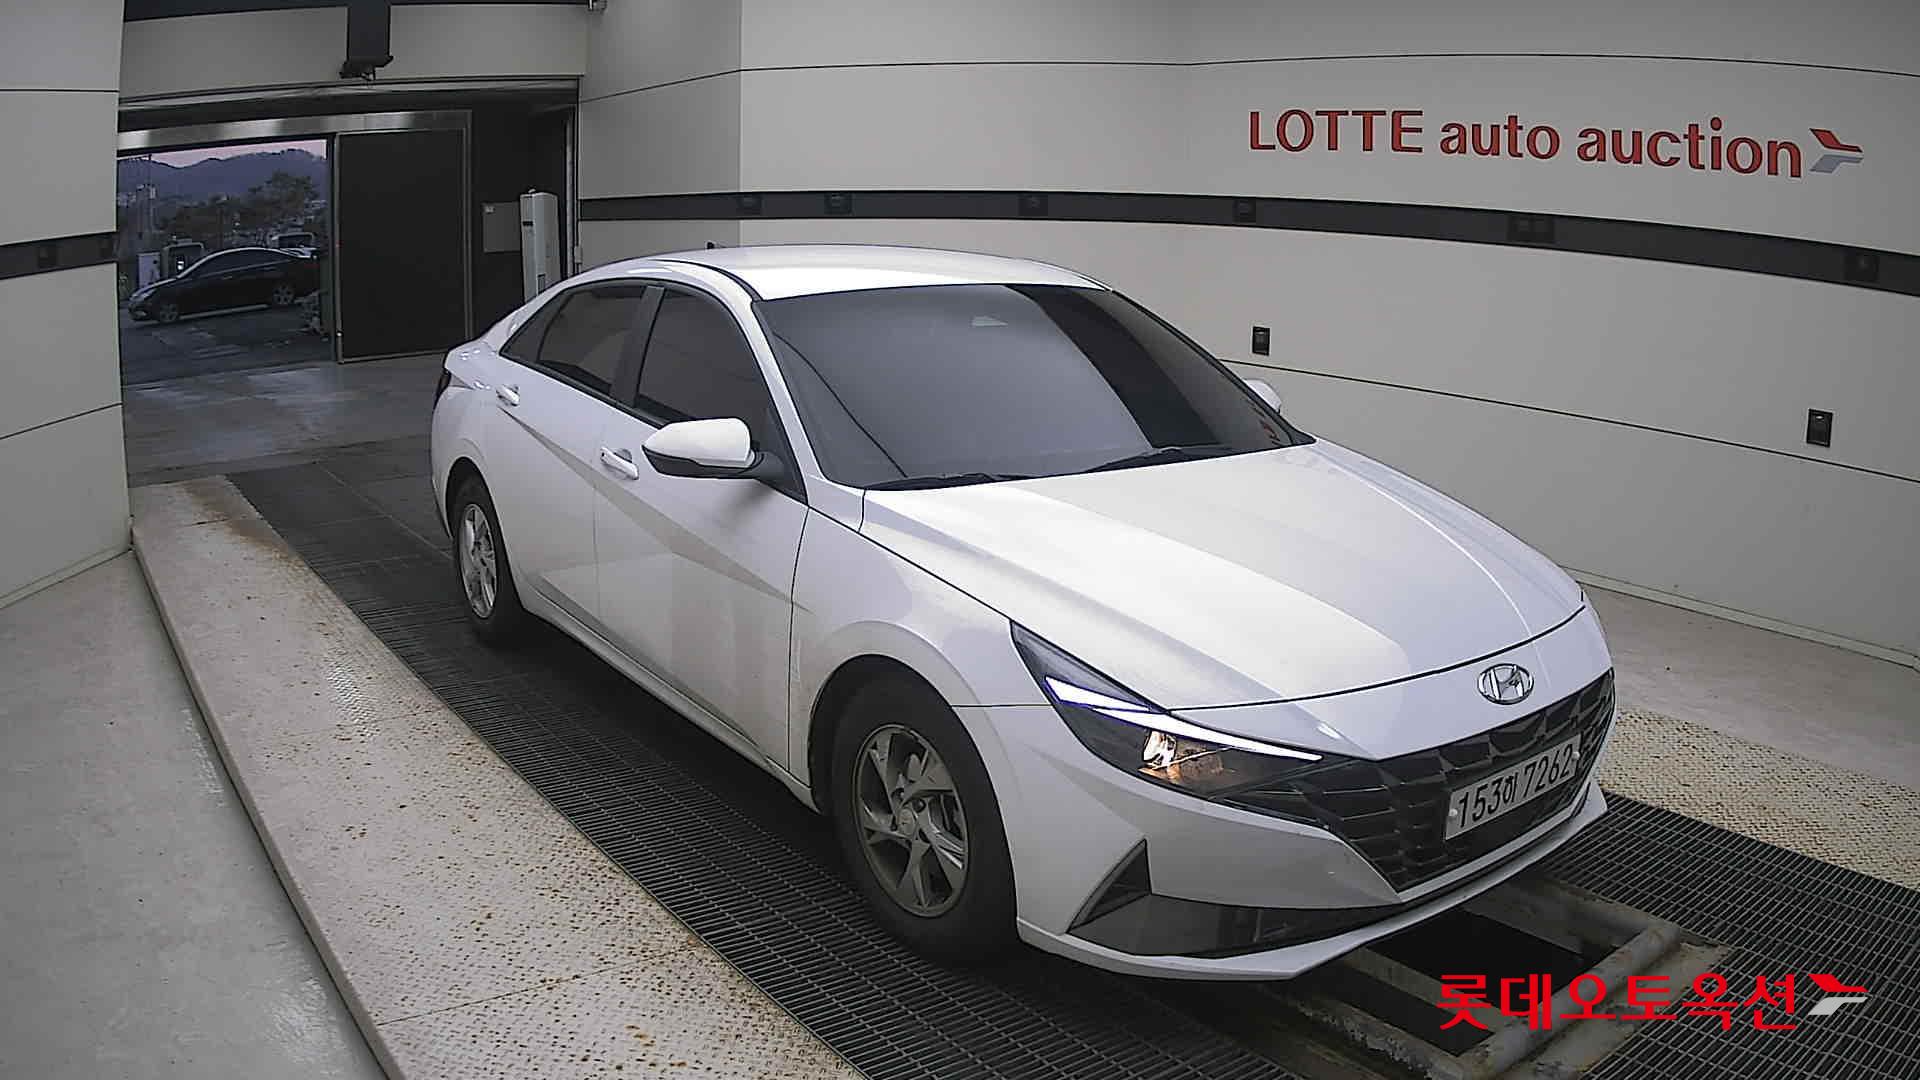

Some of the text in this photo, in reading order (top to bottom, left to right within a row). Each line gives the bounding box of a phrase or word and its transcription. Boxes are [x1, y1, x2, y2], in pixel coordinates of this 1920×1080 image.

[1248, 109, 1803, 179] LOTTE auto auction
[1522, 743, 1573, 799] 7262
